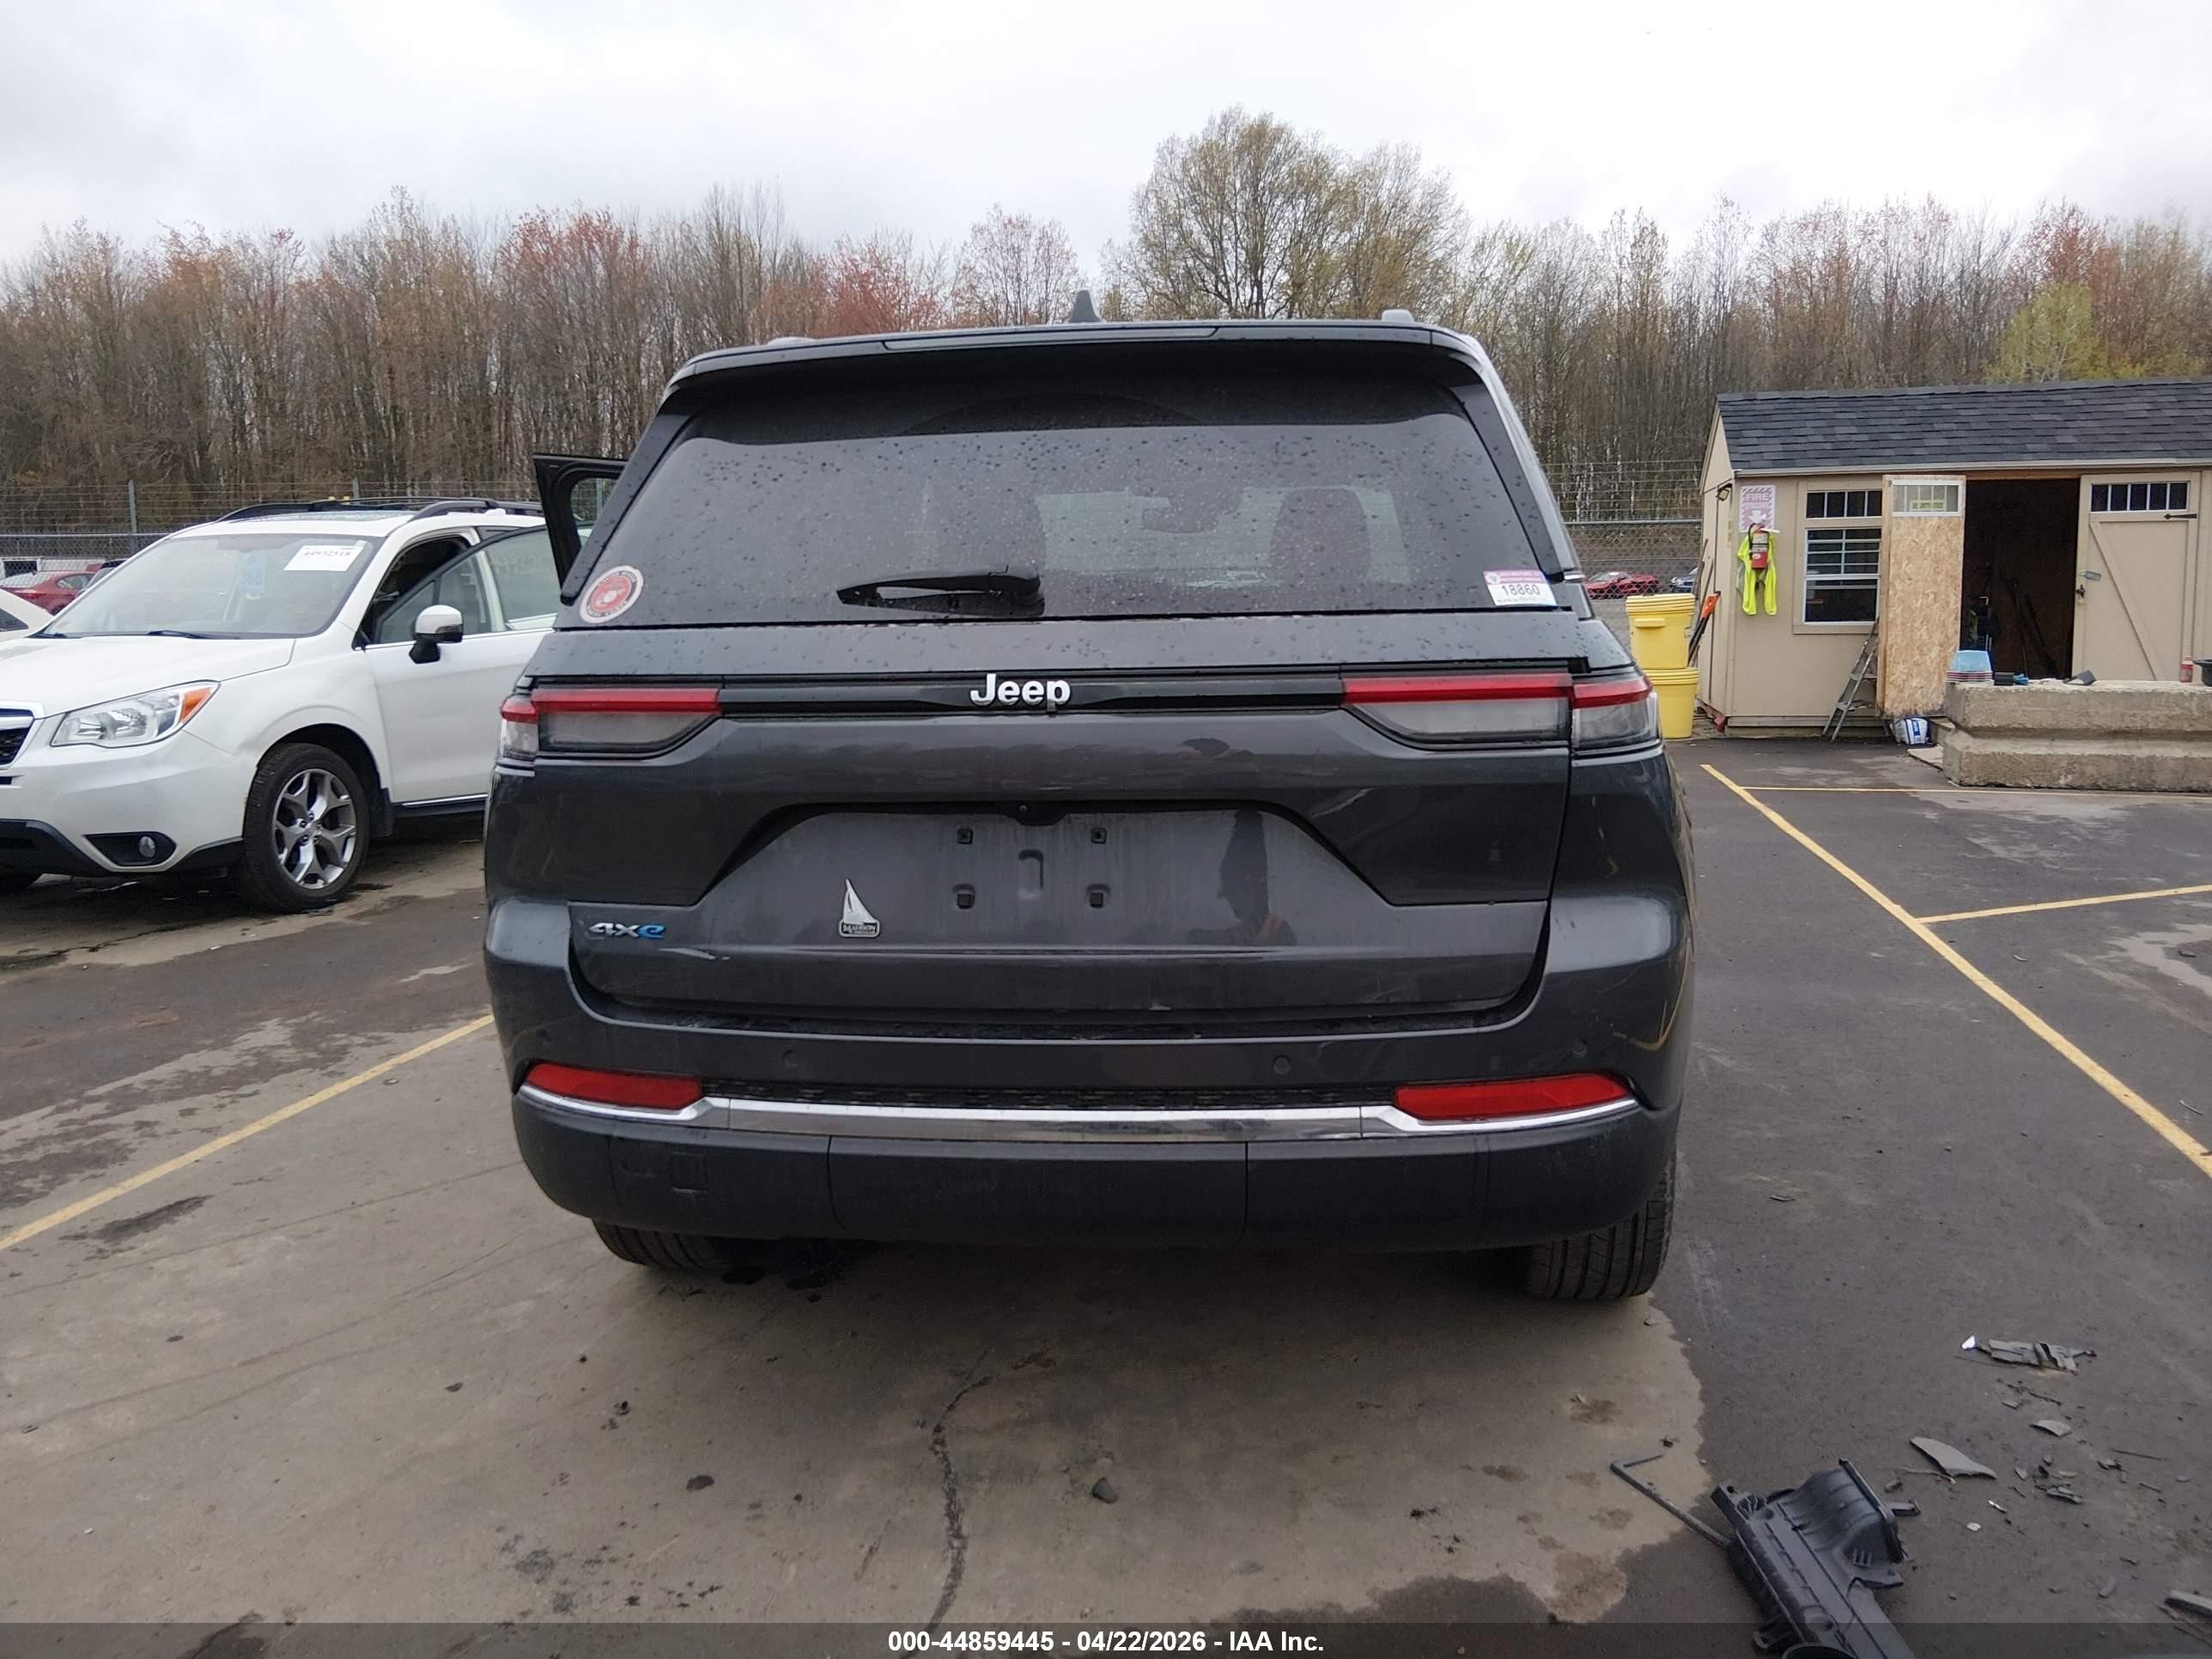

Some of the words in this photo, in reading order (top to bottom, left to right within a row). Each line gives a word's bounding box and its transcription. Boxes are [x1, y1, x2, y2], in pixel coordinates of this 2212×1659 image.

[1745, 492, 1770, 501] FIRE
[1500, 584, 1540, 596] 18860
[970, 673, 1071, 712] Jeep
